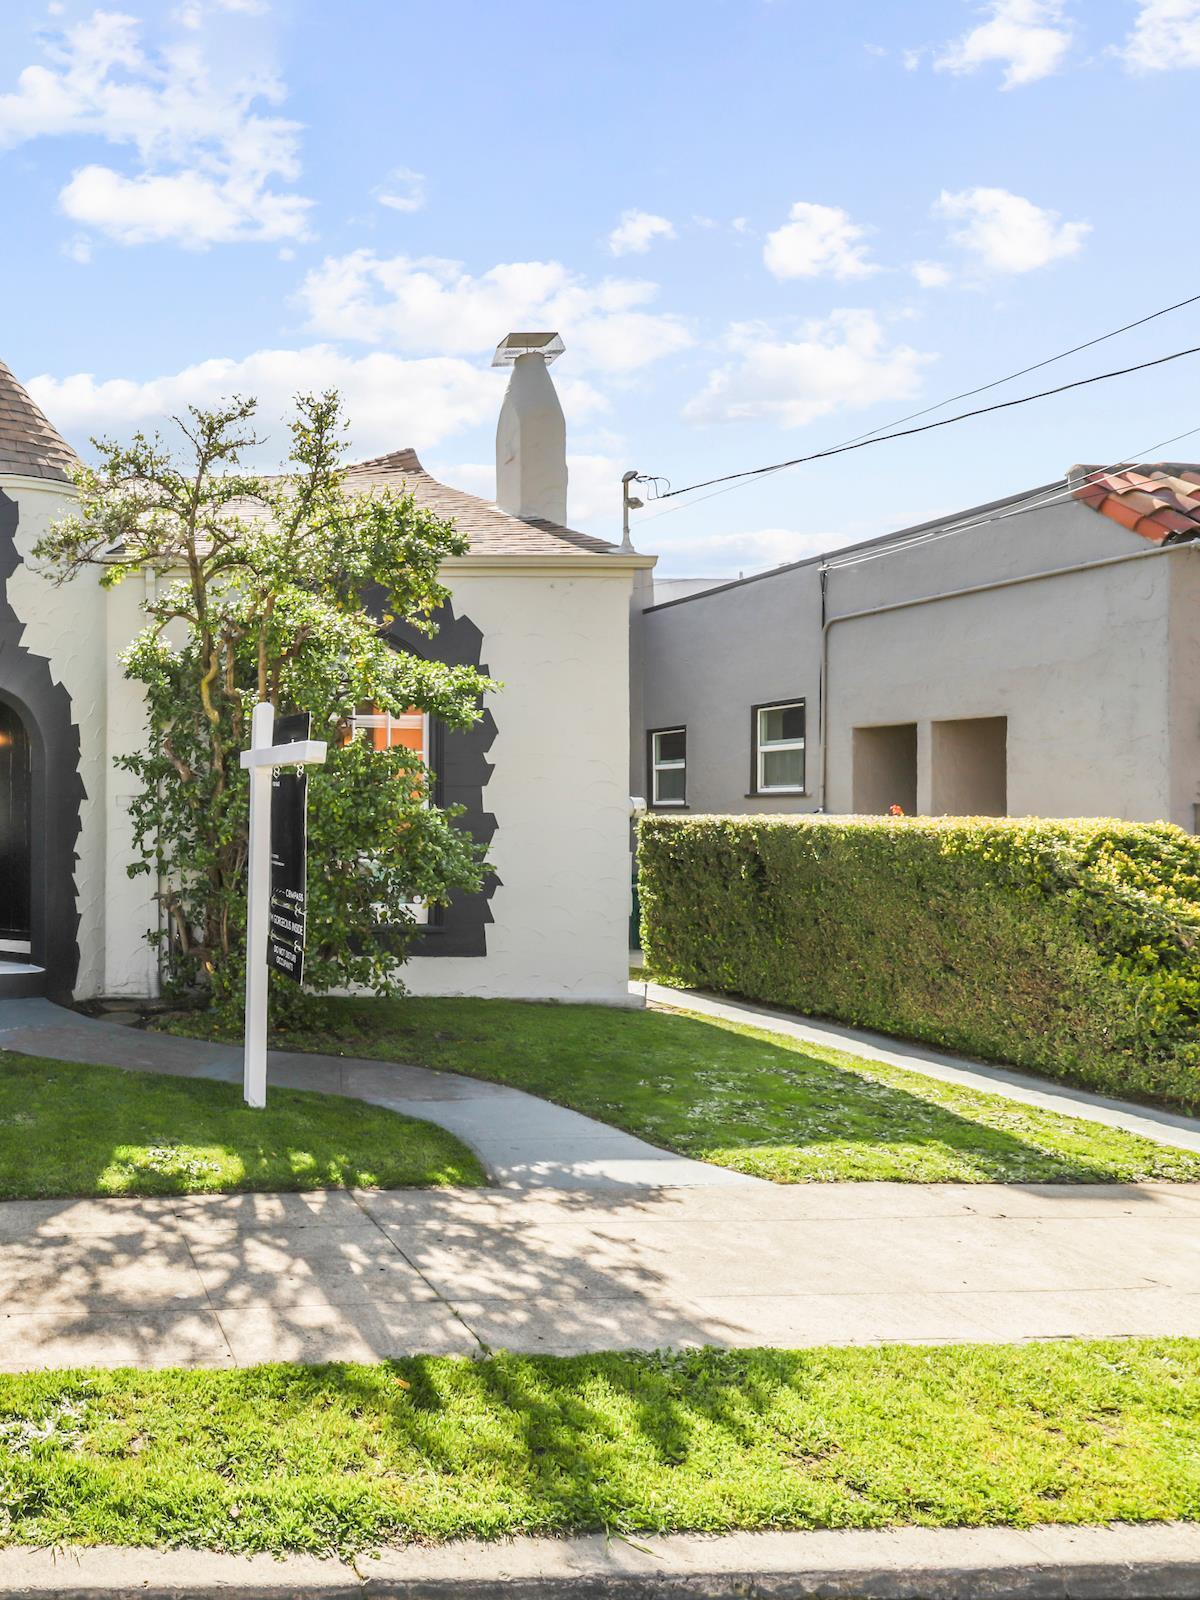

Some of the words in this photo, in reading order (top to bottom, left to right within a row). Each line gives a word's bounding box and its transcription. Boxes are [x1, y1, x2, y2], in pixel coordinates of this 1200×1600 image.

[285, 889, 304, 902] COMPASS
[274, 914, 291, 931] GORGEOUS
[291, 922, 304, 936] INSIDE
